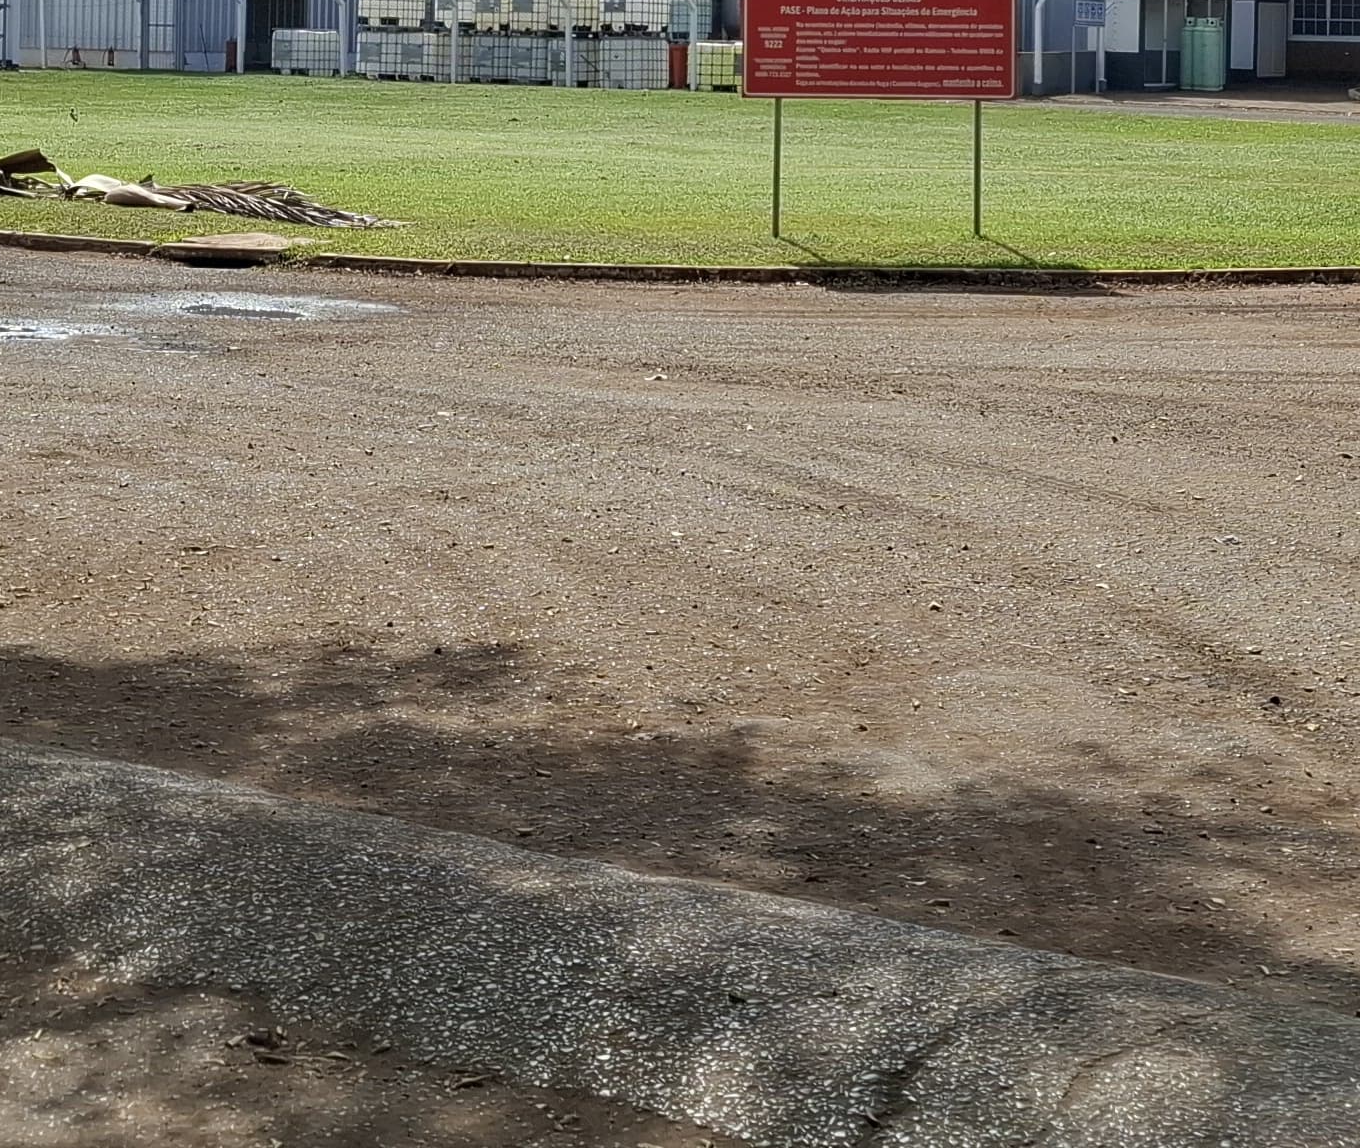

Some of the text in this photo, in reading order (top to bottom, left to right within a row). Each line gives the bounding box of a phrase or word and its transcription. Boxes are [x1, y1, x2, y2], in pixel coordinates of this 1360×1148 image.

[780, 5, 801, 15] PASE
[806, 6, 828, 15] Plano
[829, 6, 840, 16] de
[840, 6, 861, 17] Ação
[861, 8, 880, 17] para
[920, 7, 931, 17] de
